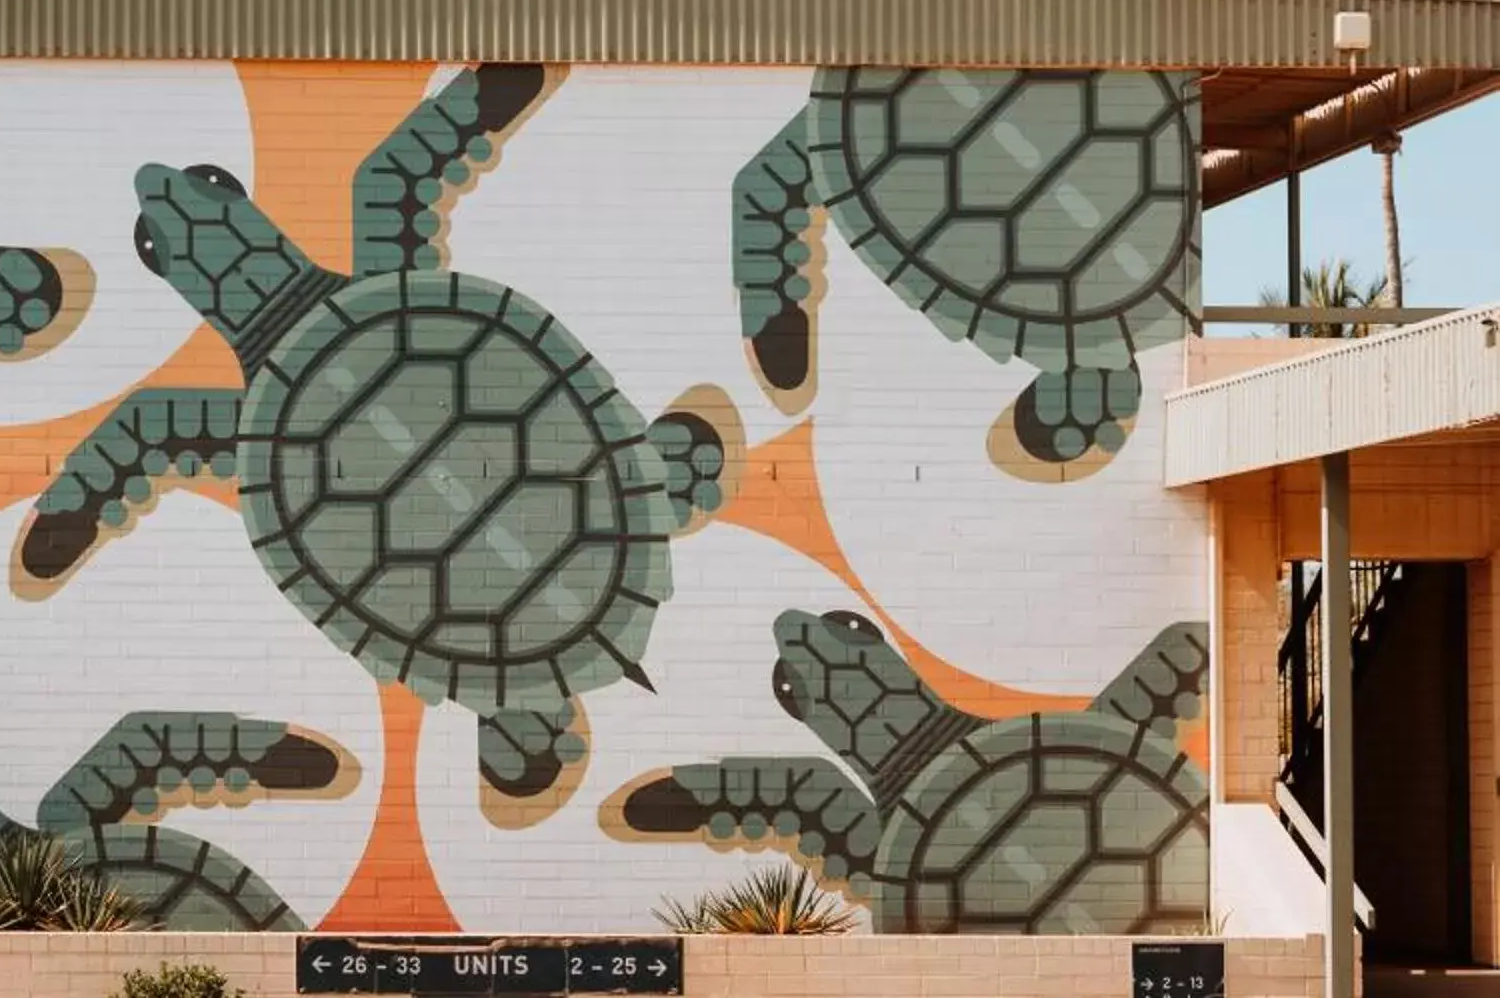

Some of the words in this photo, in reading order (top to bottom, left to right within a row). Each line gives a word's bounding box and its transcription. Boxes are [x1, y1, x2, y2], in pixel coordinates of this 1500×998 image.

[342, 955, 368, 974] 26
[396, 955, 421, 975] 33
[453, 954, 529, 976] UNITS
[570, 956, 583, 975] 2
[611, 956, 637, 975] 25
[1162, 976, 1172, 989] 2
[1190, 976, 1204, 989] 13
